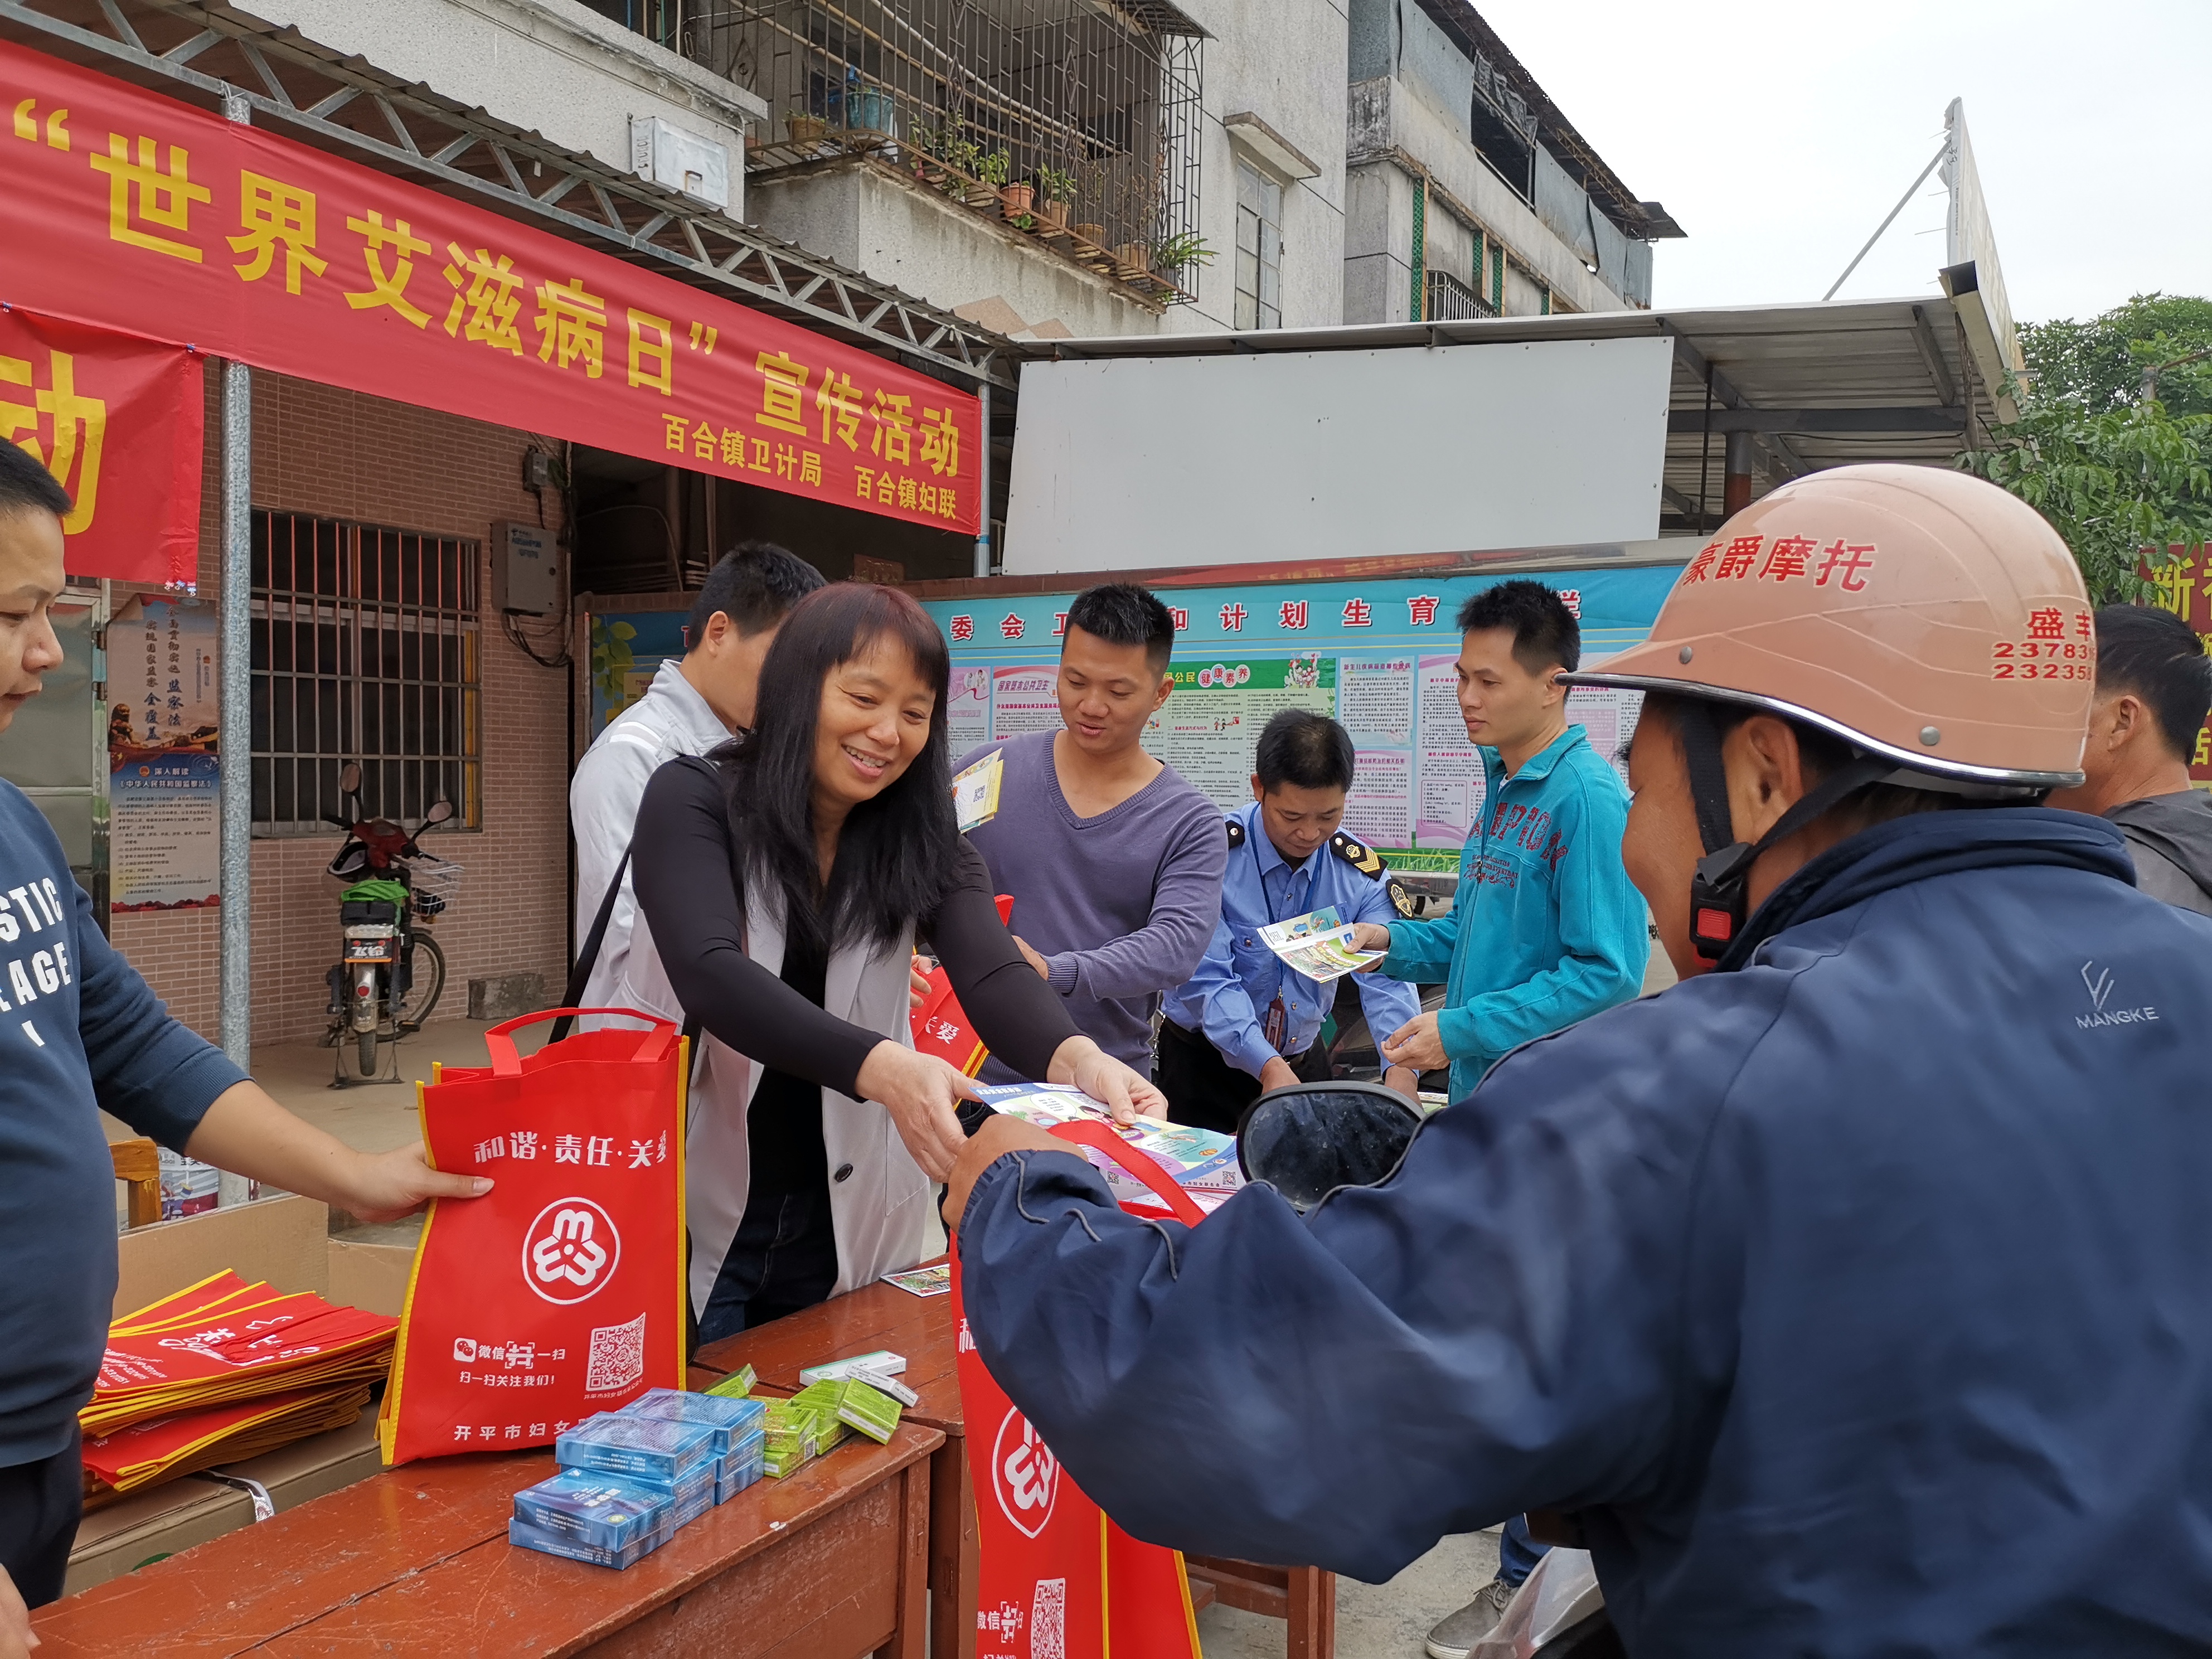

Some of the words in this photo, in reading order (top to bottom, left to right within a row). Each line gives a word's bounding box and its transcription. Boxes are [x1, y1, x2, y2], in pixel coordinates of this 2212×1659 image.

[662, 413, 822, 487] 百合镇卫计局
[855, 465, 956, 520] 百合镇妇联
[1682, 533, 1878, 593] 豪爵摩托
[2074, 1006, 2161, 1030] MANGKE
